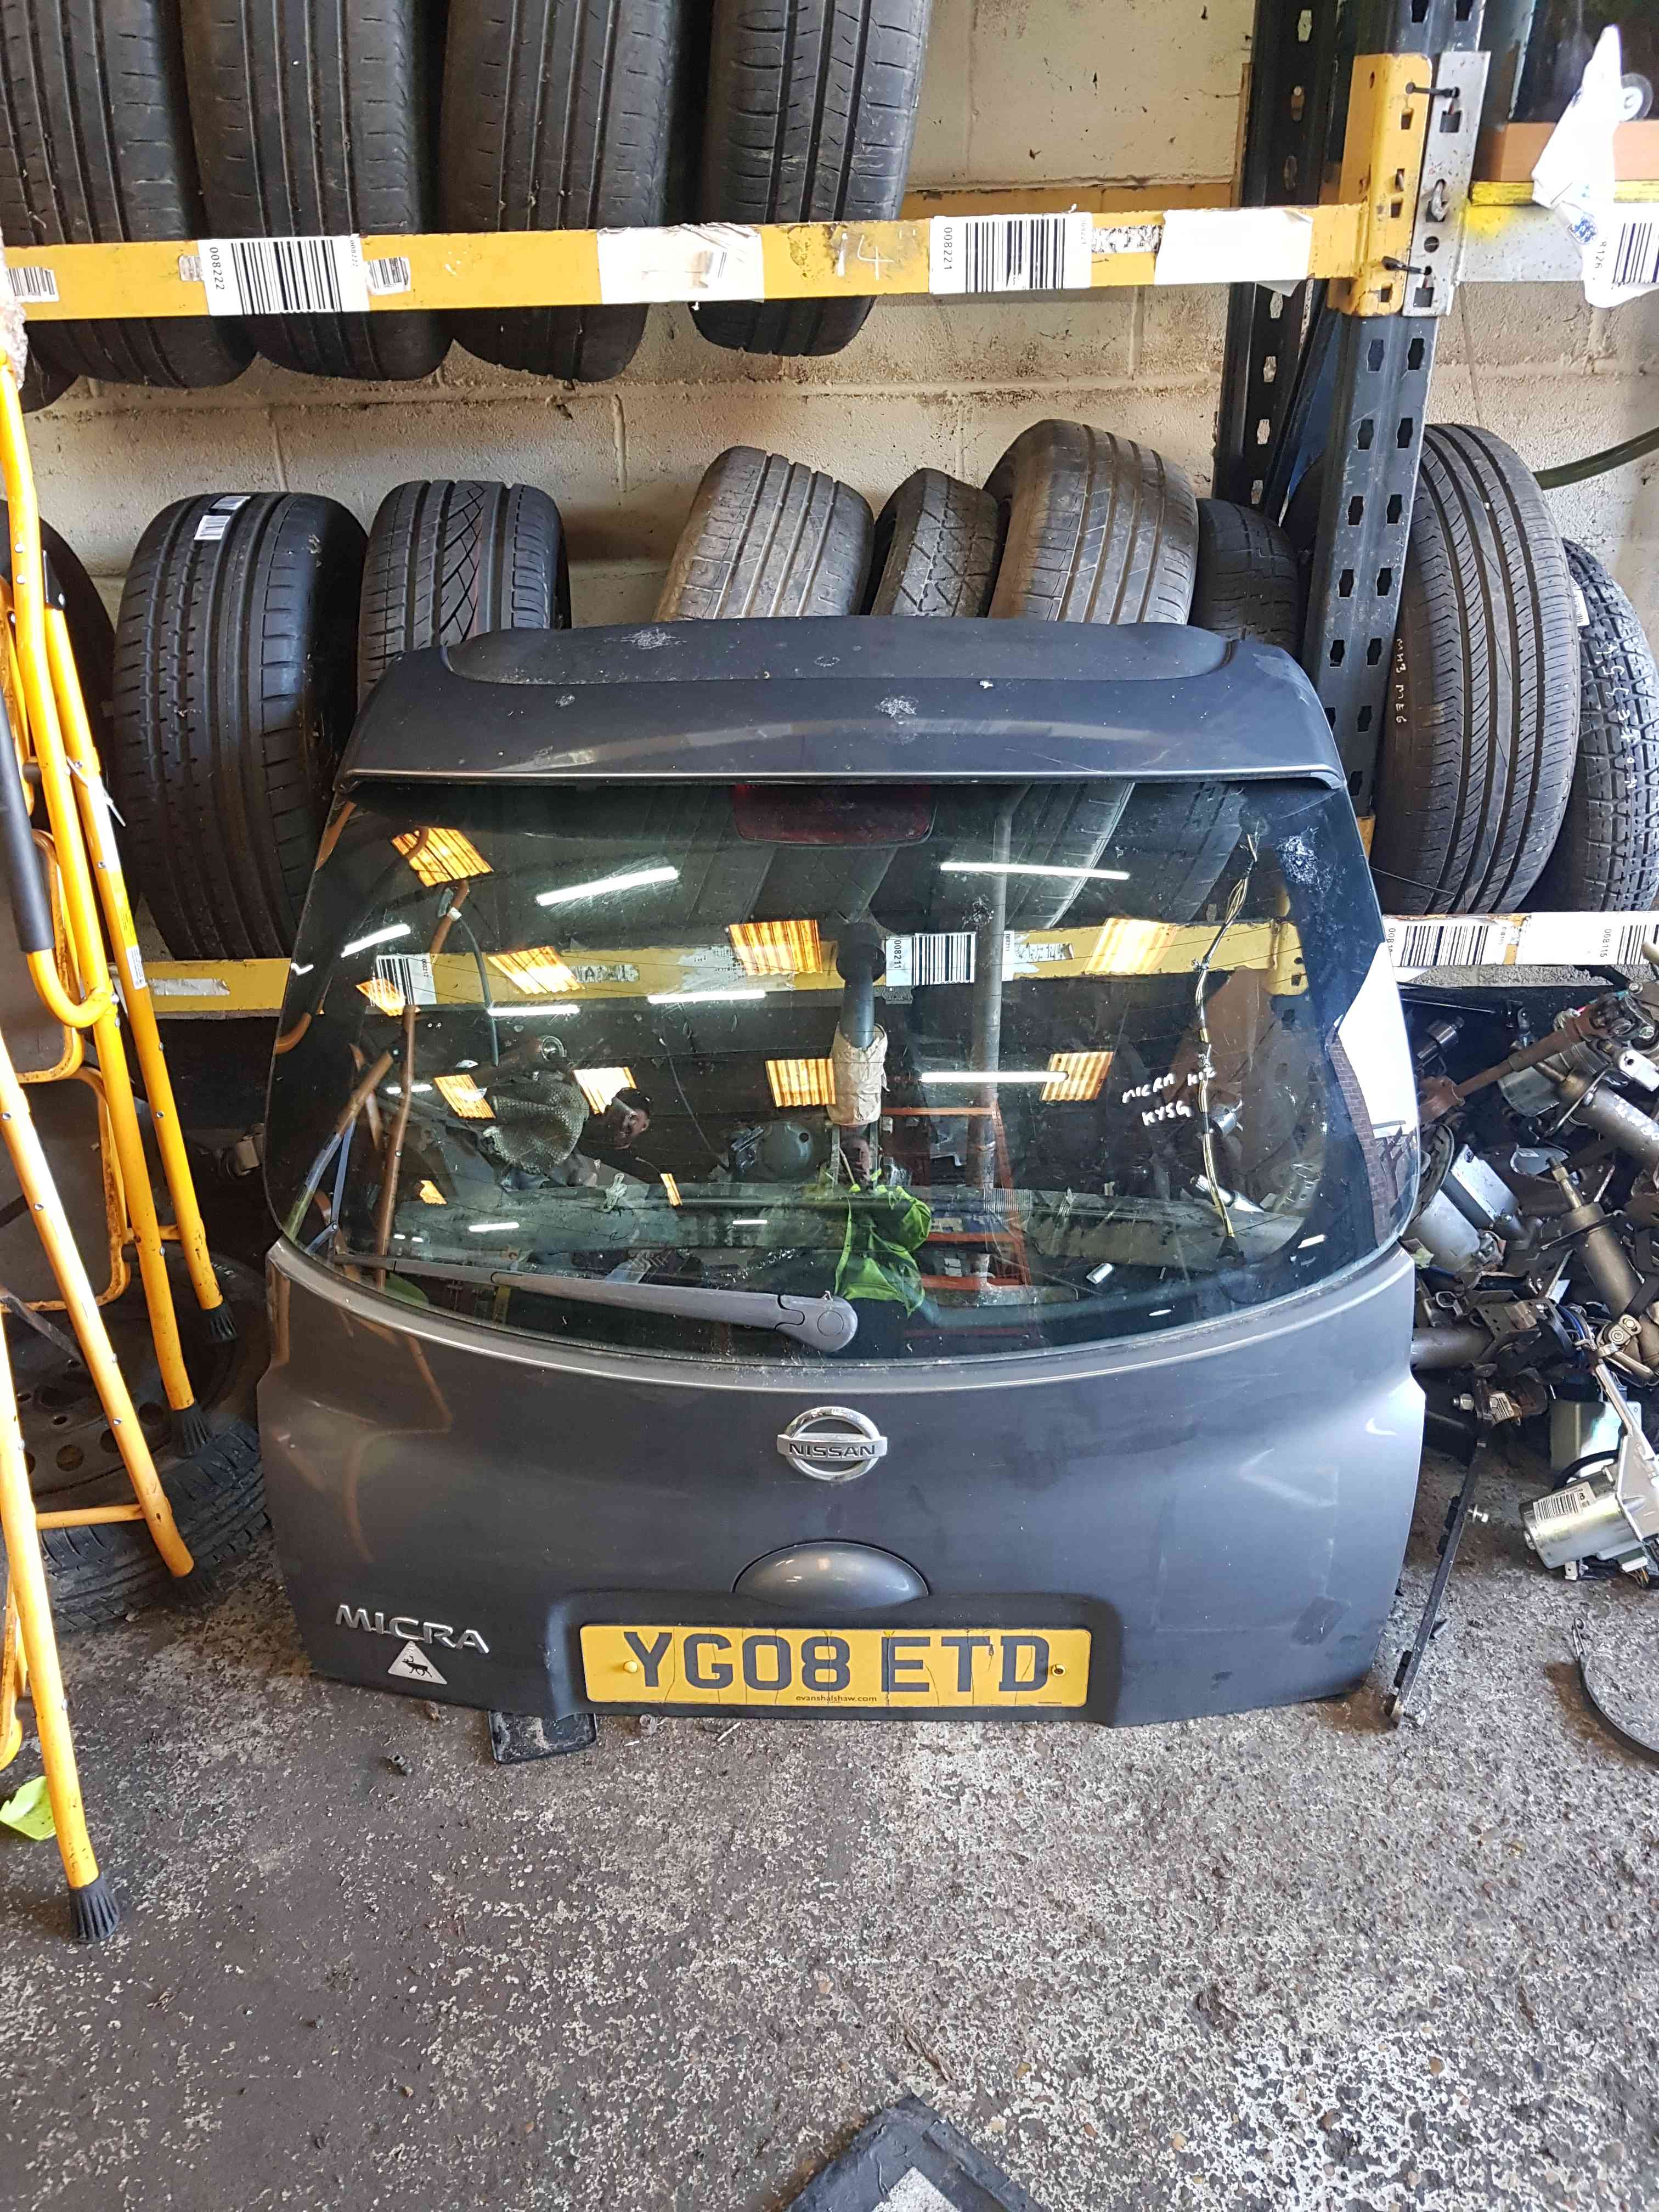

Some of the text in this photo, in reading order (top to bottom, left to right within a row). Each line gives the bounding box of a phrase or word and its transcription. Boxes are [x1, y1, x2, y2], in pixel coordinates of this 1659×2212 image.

[210, 246, 225, 290] 008222
[943, 227, 953, 270] 008221
[894, 940, 902, 969] 008211
[1122, 1073, 1176, 1104] MICRA
[788, 1443, 875, 1458] NISSAN
[335, 1604, 490, 1654] MICRA
[623, 1631, 1051, 1692] YG08 ETD
